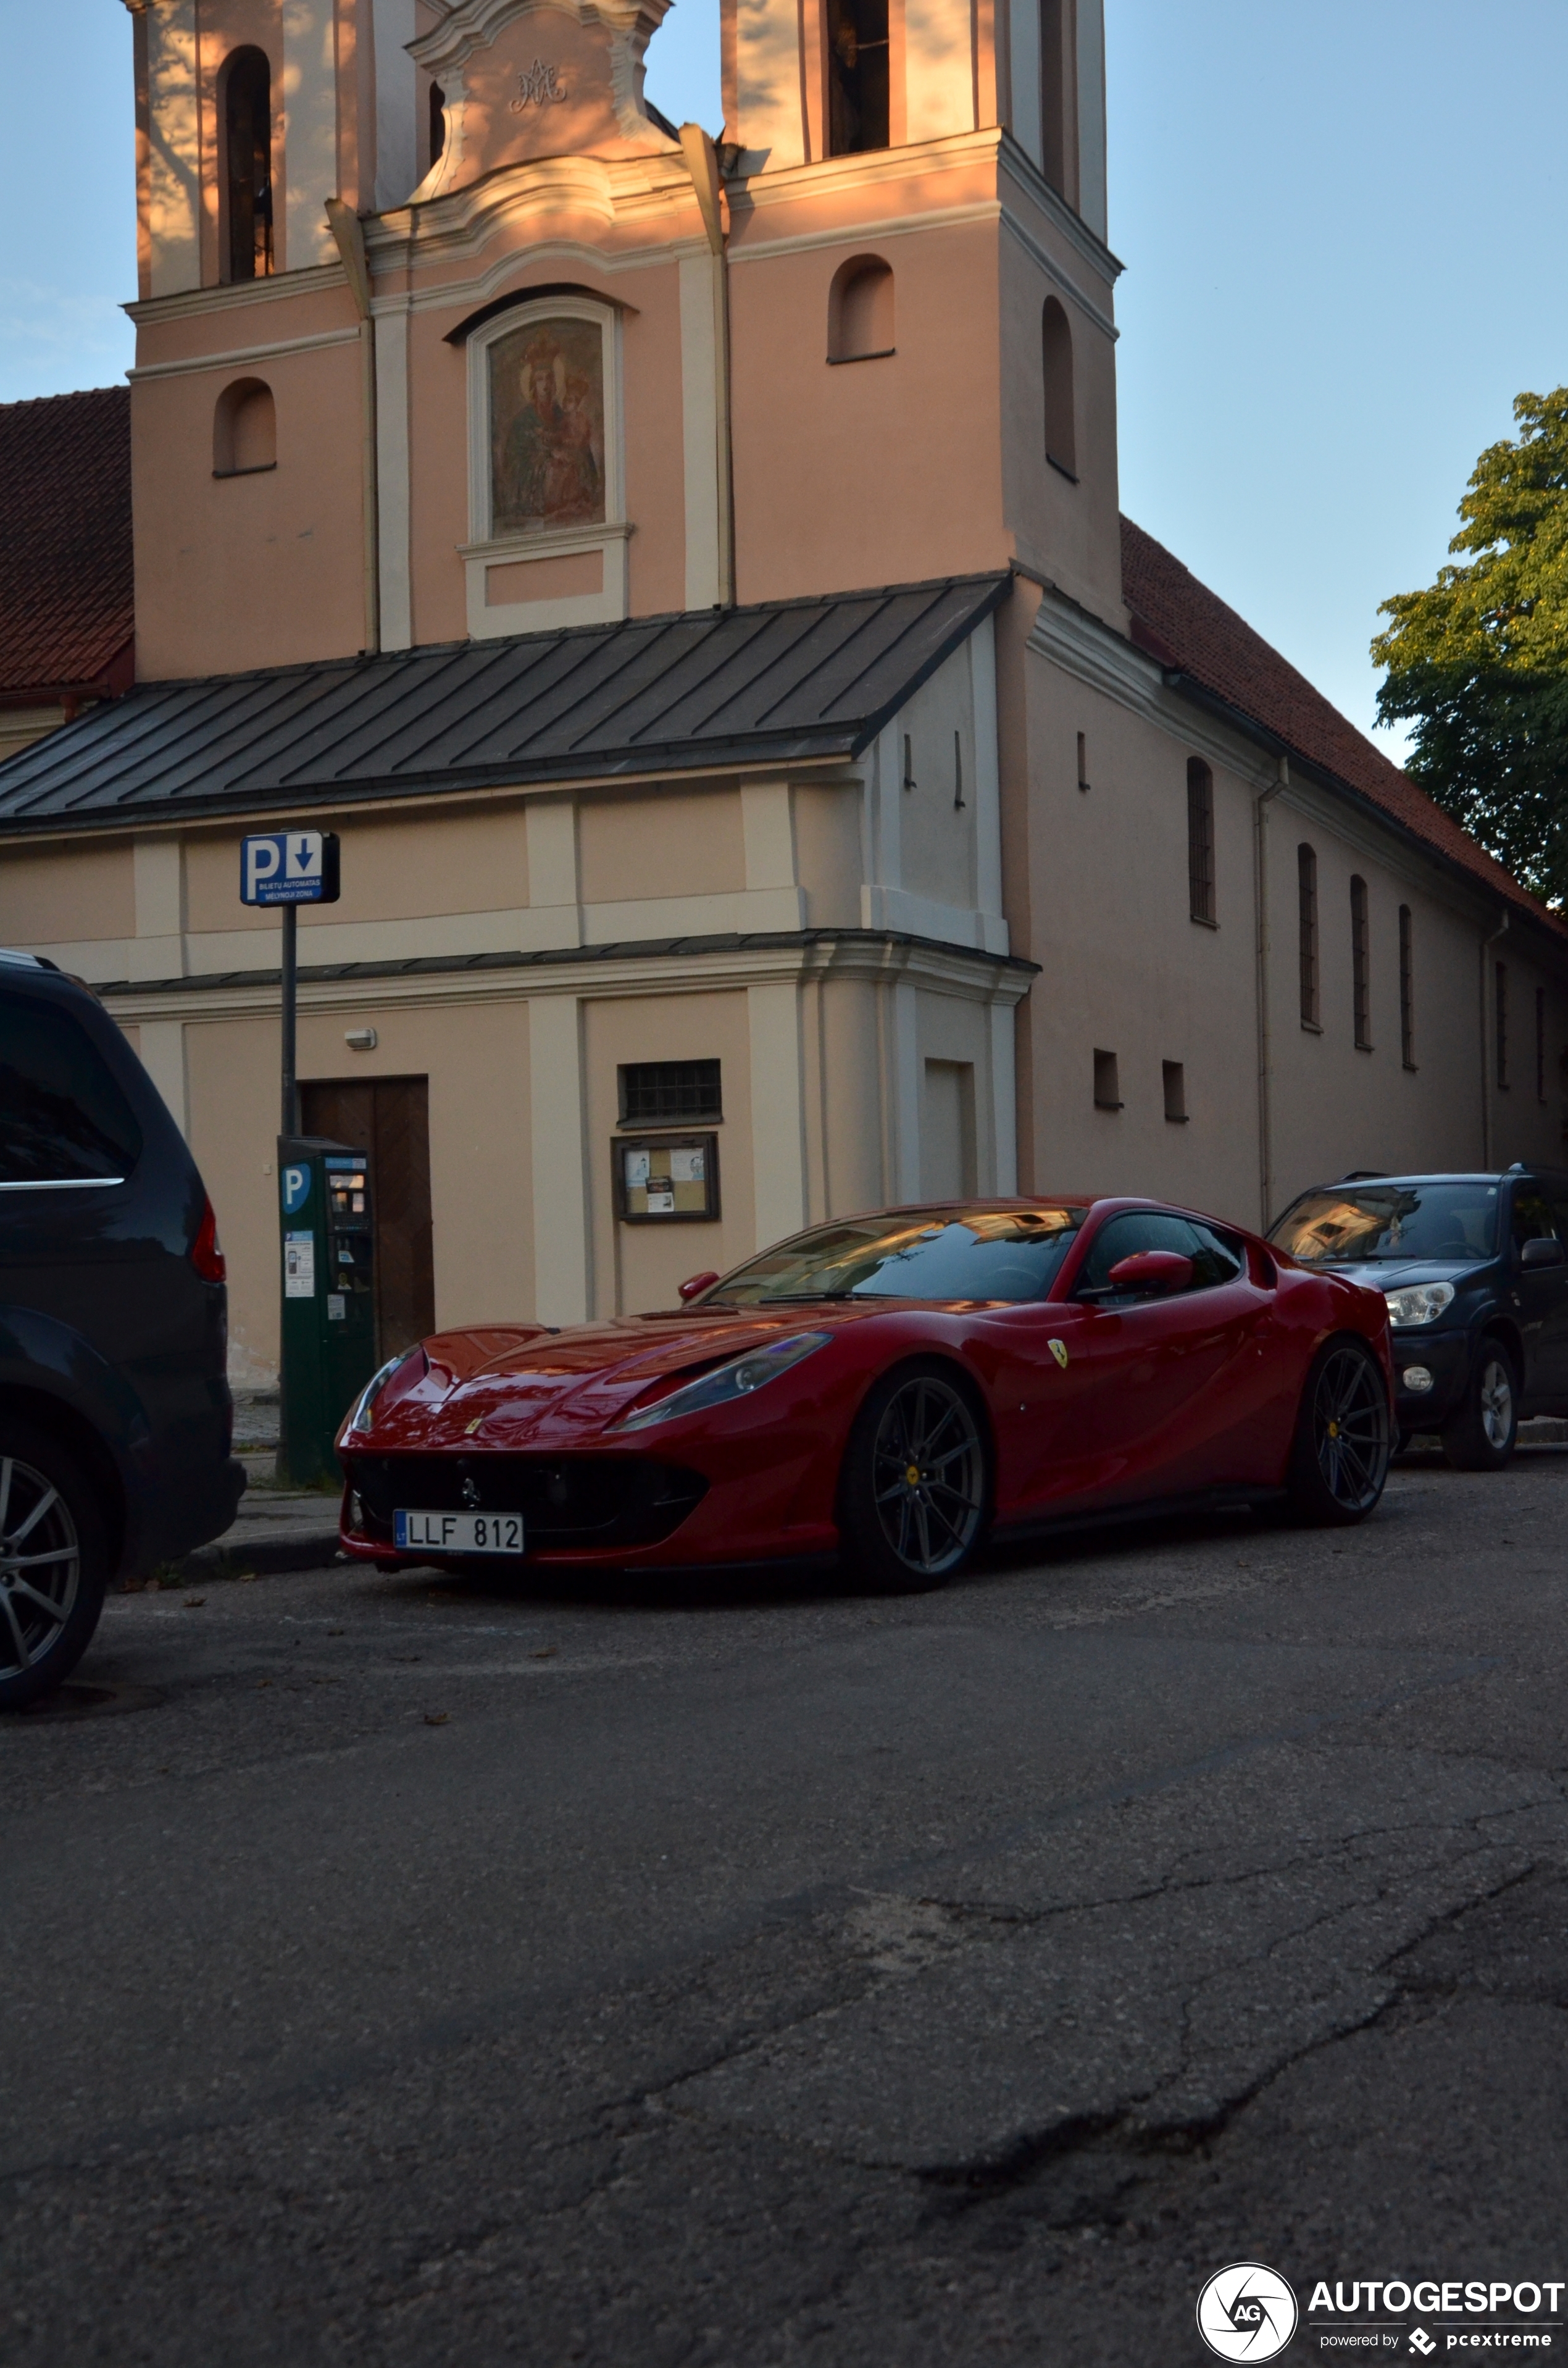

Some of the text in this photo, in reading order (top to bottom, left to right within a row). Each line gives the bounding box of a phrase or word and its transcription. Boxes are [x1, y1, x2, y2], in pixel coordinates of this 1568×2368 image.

[248, 840, 280, 900] P
[259, 879, 320, 890] BILIETŲ AUTOMATAS
[286, 1169, 303, 1204] P
[396, 1532, 406, 1541] LT
[409, 1516, 520, 1548] LLF 812
